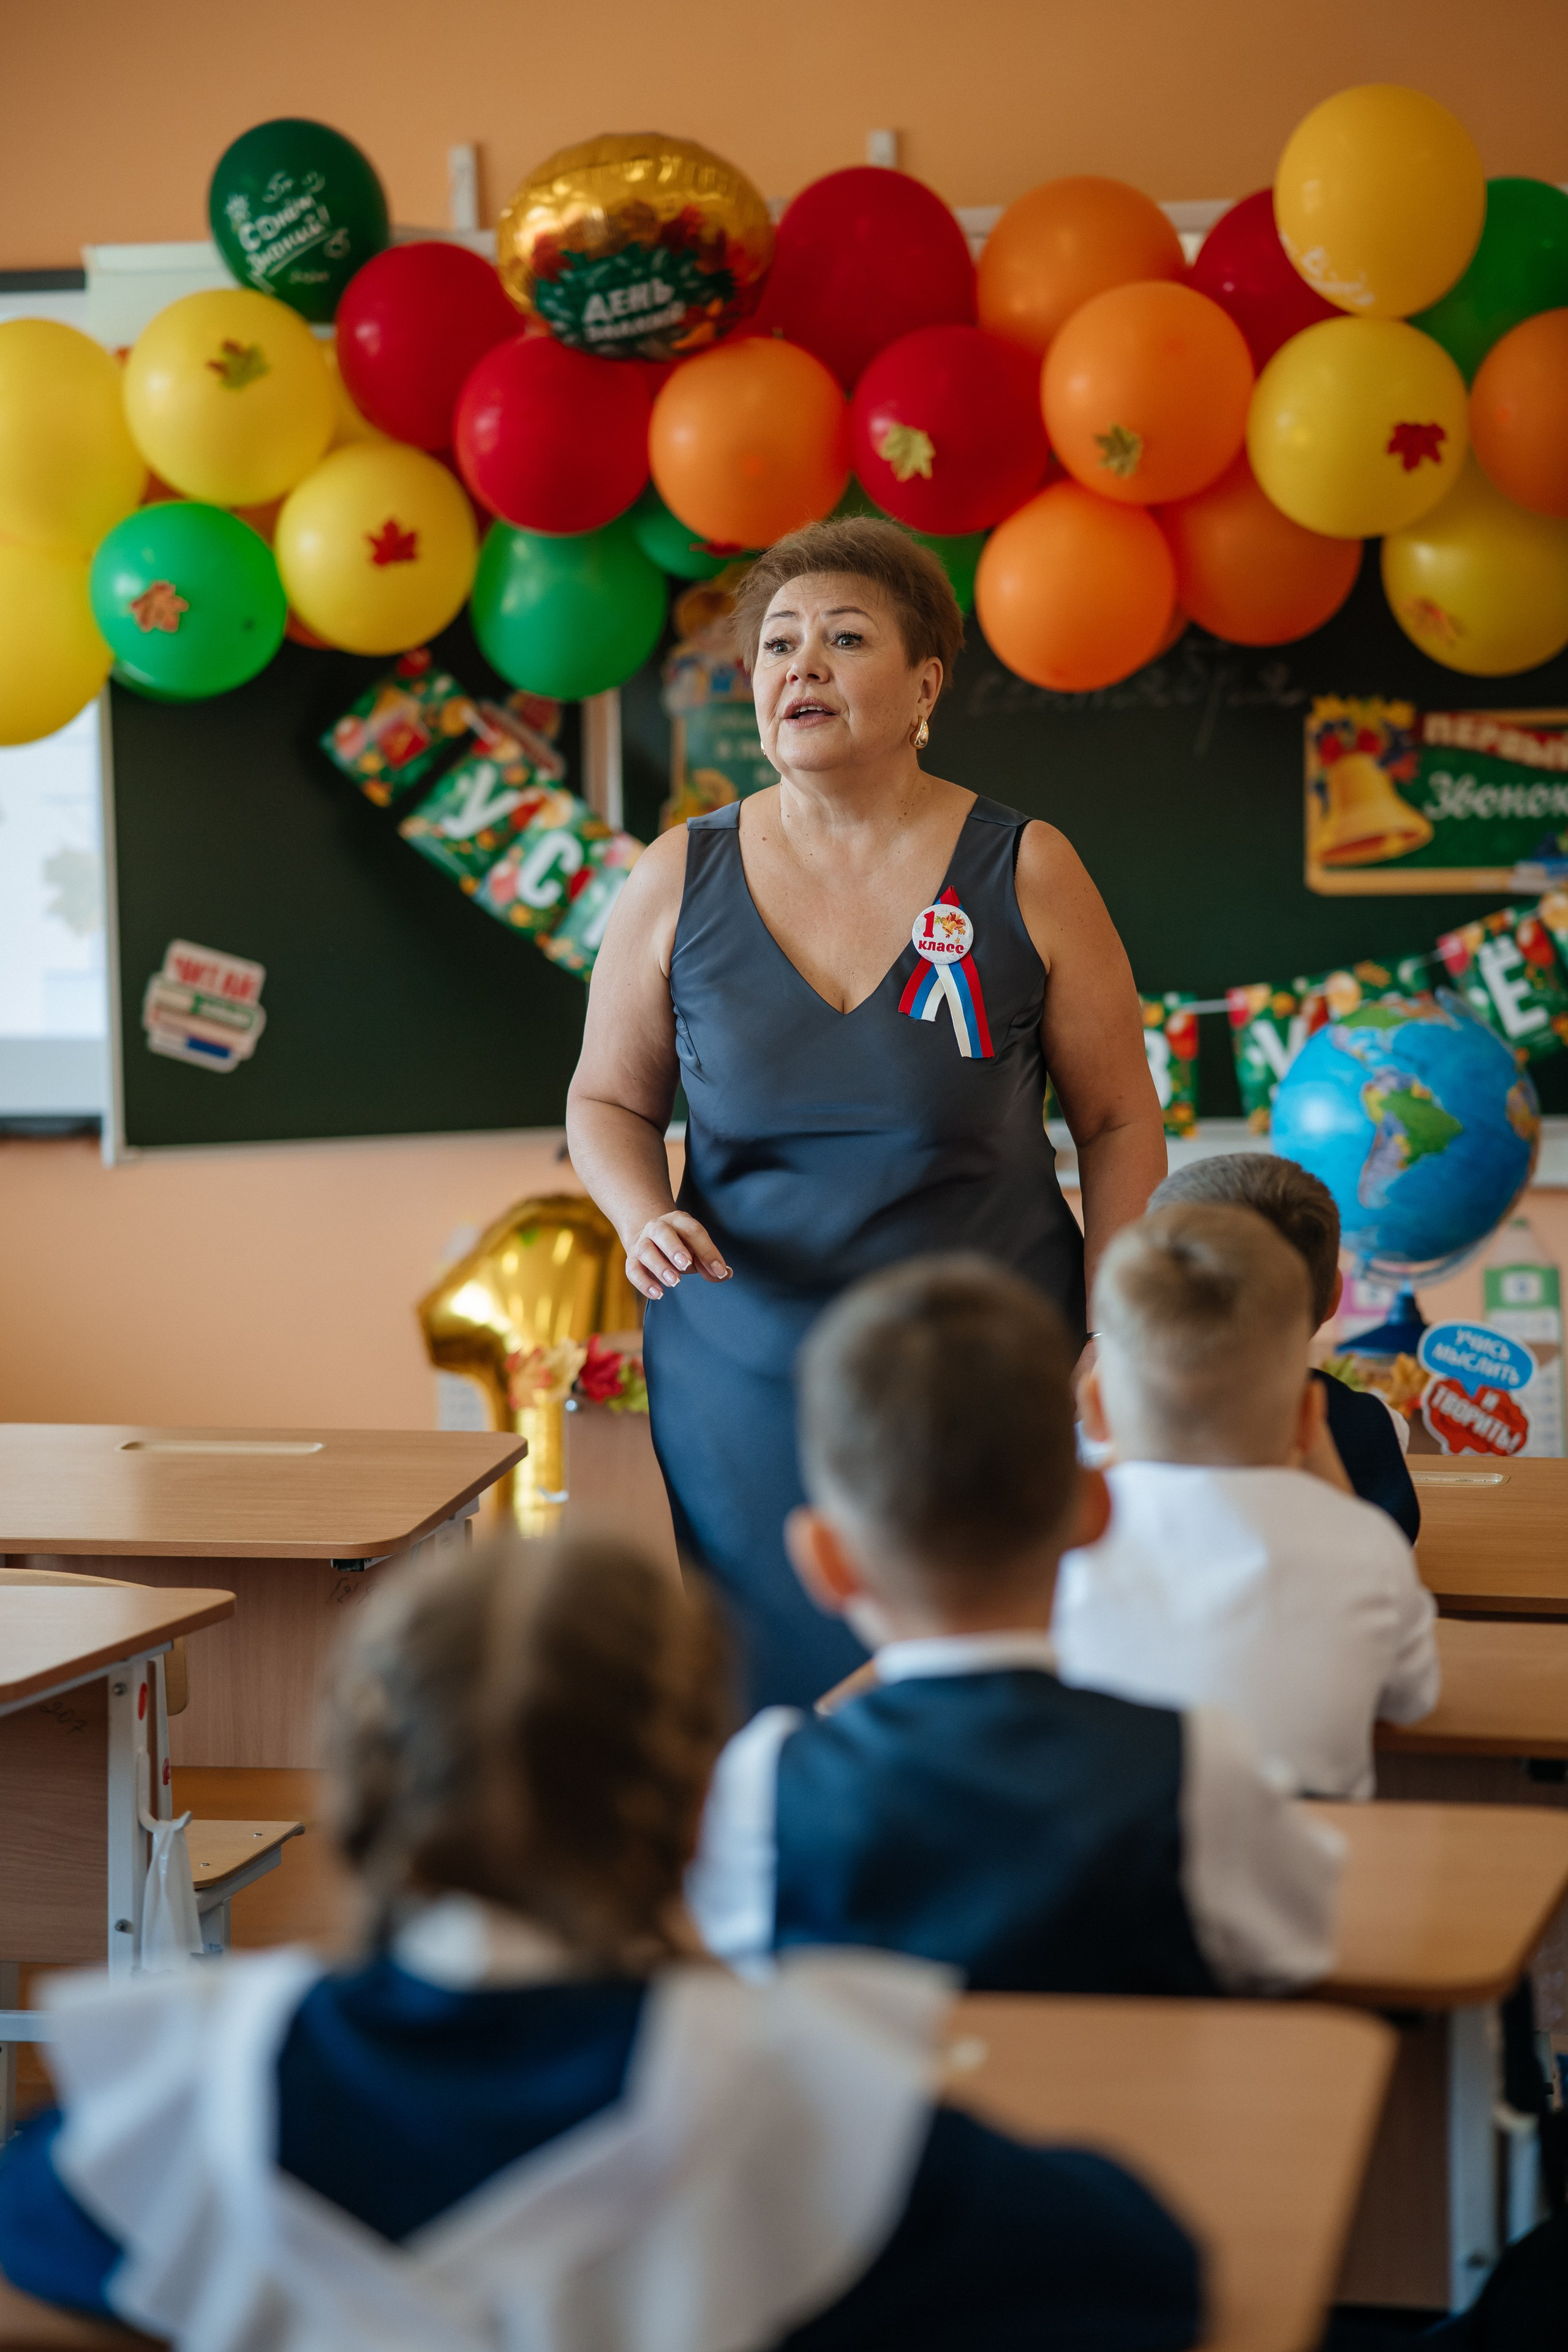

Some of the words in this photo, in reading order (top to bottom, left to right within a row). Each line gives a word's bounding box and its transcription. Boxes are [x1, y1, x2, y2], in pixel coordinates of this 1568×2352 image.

[582, 277, 674, 324] ДЕНЬ
[922, 911, 935, 938] 1
[918, 940, 964, 954] класс
